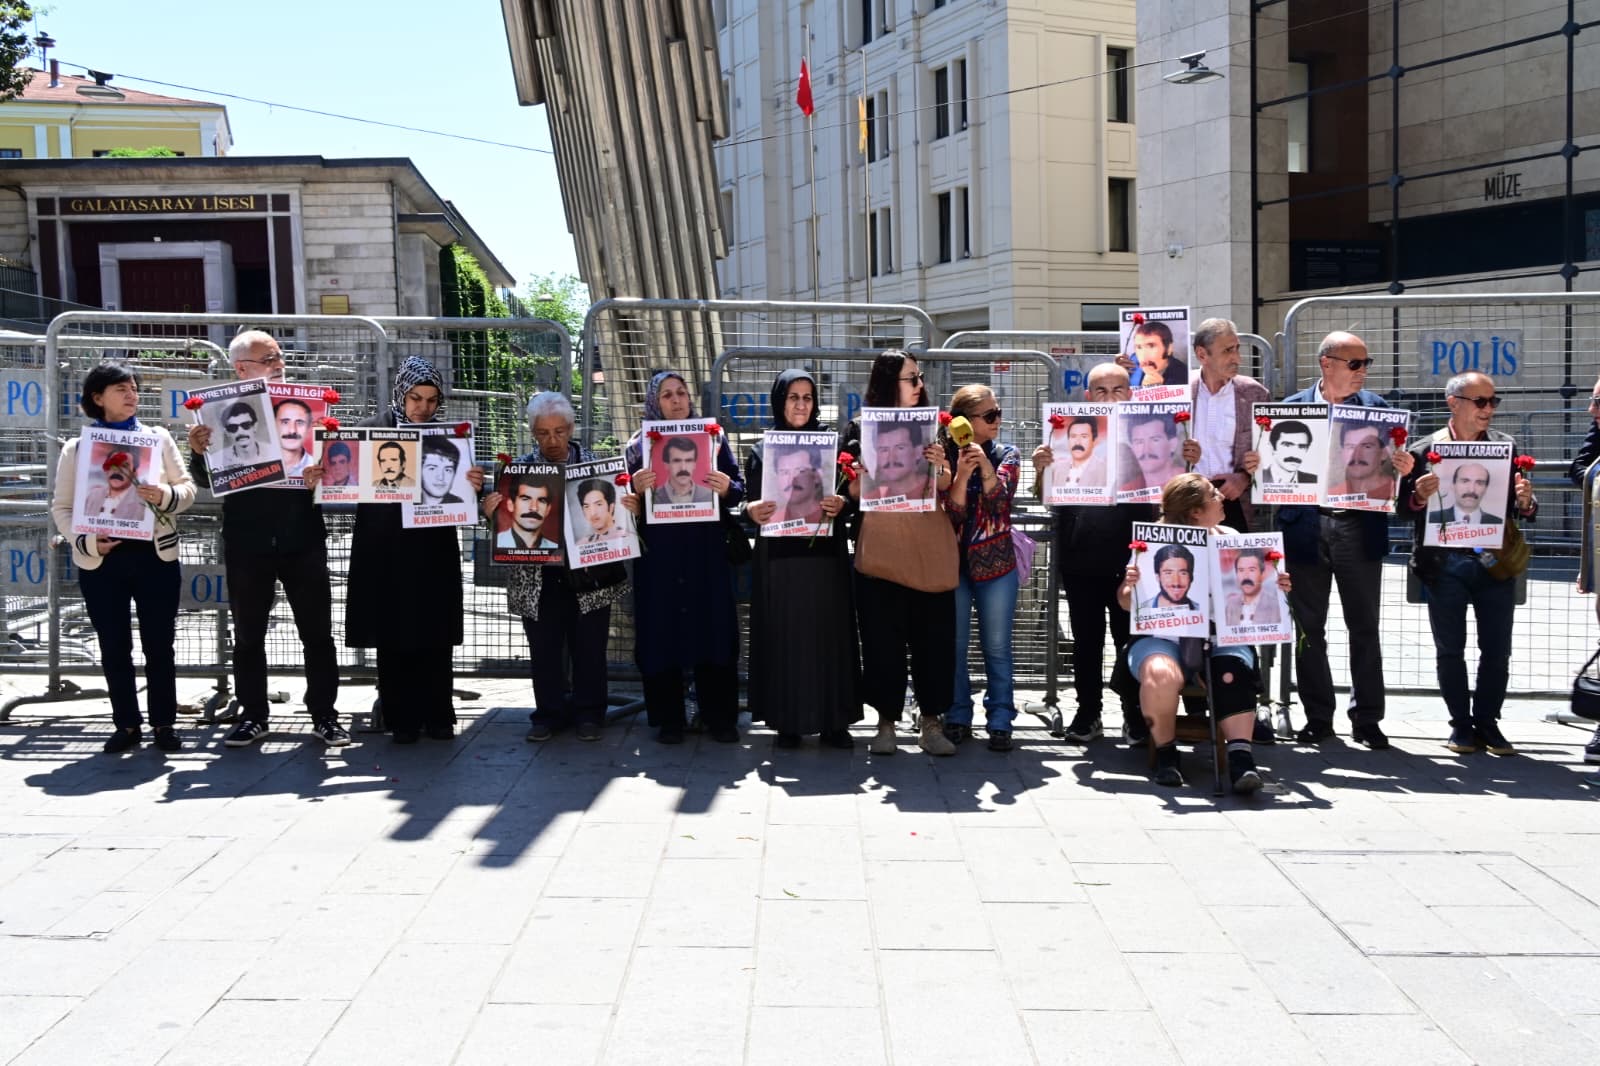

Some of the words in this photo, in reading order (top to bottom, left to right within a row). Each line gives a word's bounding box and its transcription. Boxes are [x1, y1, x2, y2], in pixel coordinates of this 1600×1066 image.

[1485, 172, 1522, 201] MÜZE
[71, 198, 196, 211] GALATASARAY
[202, 195, 255, 210] LİSESİ
[1432, 336, 1517, 376] POLİS
[240, 382, 263, 393] EREN
[268, 386, 291, 395] NAN
[1077, 406, 1113, 415] ALPSOY
[1152, 404, 1190, 414] ALPSOY
[1255, 406, 1300, 416] SÜLEYMAN
[1301, 406, 1327, 416] CİHAN
[863, 411, 895, 422] KASIM
[898, 411, 936, 422] ALPSOY
[1334, 408, 1365, 420] KASIM
[1368, 412, 1407, 424] ALPSOY
[90, 432, 119, 443] HALİL
[120, 435, 160, 447] ALPSOY
[765, 434, 796, 444] KASIM
[798, 435, 835, 446] ALPSOY
[504, 464, 528, 474] AGİT
[528, 464, 559, 474] AKİPA
[566, 466, 592, 479] URAT
[593, 461, 625, 474] YILDIZ
[1263, 493, 1317, 502] KAYBEDİLDİ
[413, 512, 467, 525] KAYBEDİLDİ
[1137, 526, 1174, 542] HASAN
[1177, 529, 1205, 545] OCAK
[1216, 539, 1241, 549] HALİL
[1244, 538, 1279, 547] ALPSOY
[580, 546, 631, 564] KAYBEDİLDİ
[1136, 613, 1204, 631] KAYBEDİLDİ
